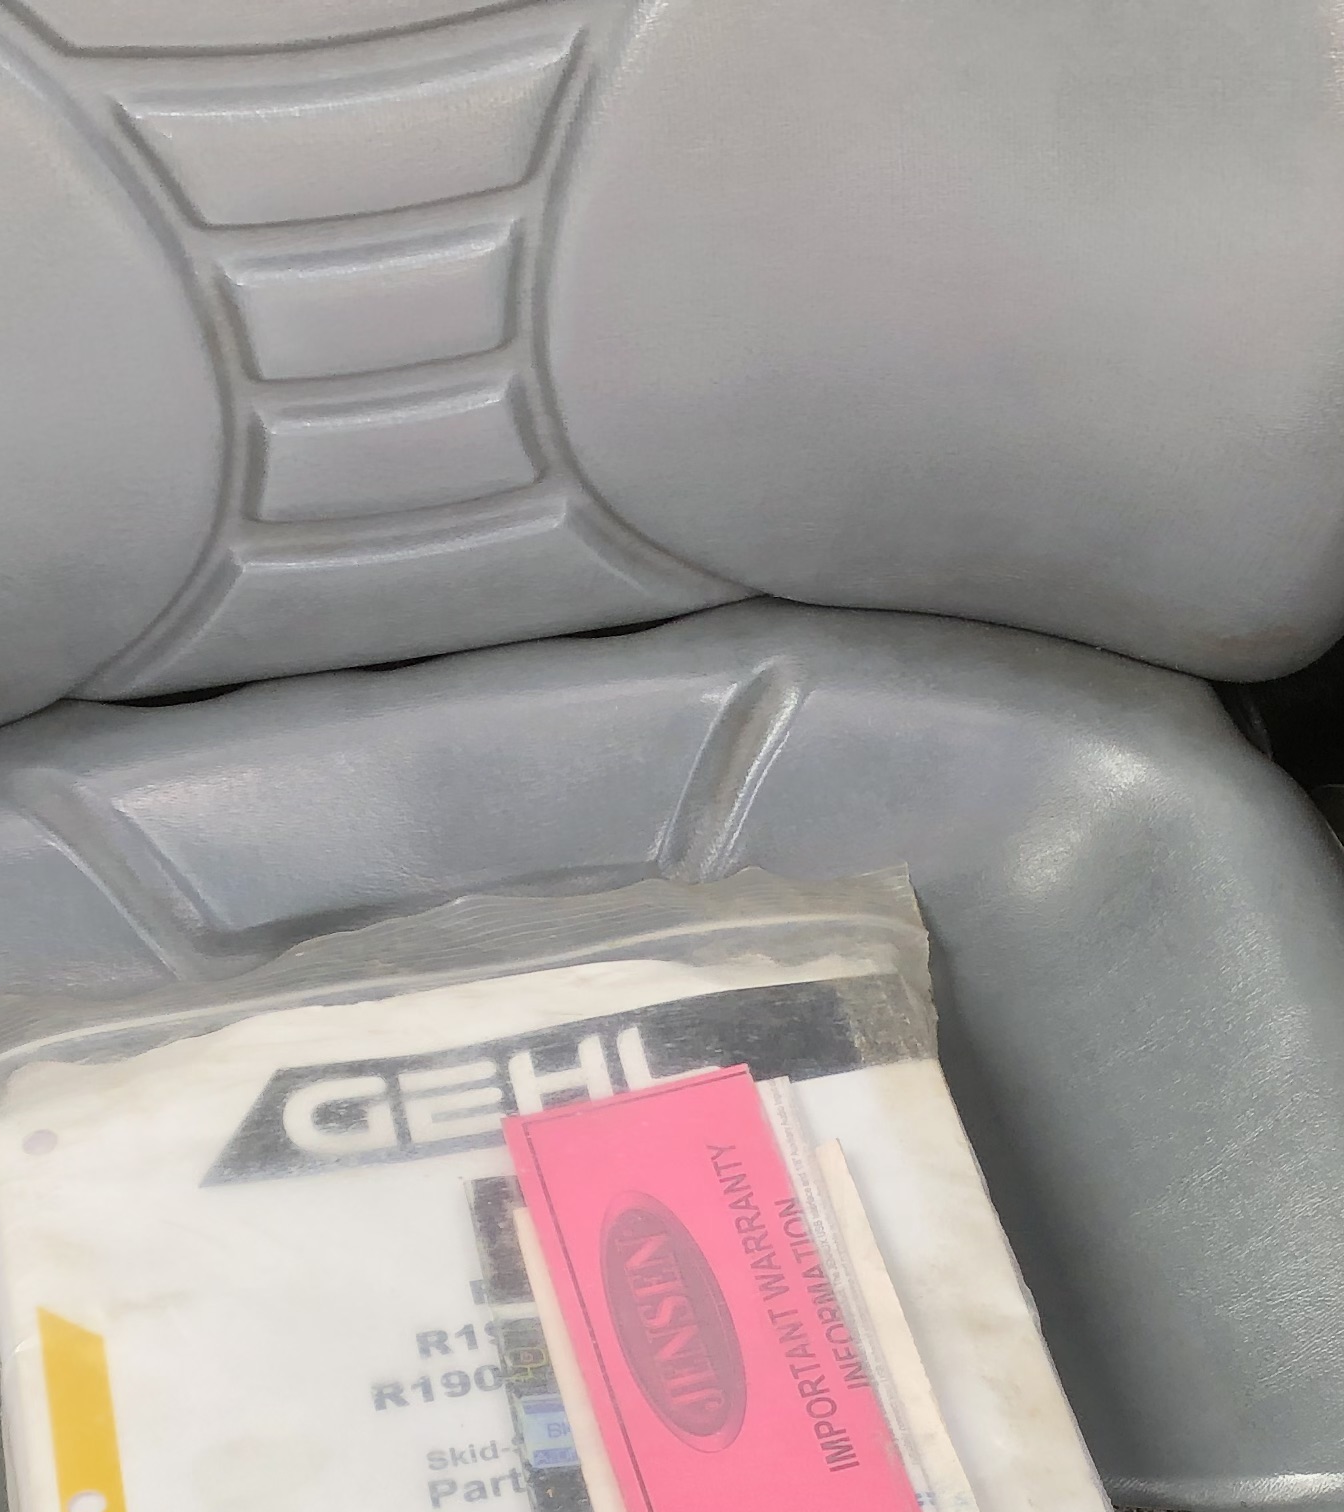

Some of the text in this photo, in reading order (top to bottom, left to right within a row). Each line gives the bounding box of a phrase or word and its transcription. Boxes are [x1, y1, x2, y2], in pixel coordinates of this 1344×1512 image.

[281, 1025, 722, 1158] GEHL
[614, 1231, 723, 1411] JENSEN
[706, 1144, 861, 1472] IMPORTANT WARRANTY
[774, 1197, 871, 1390] INFORMATION
